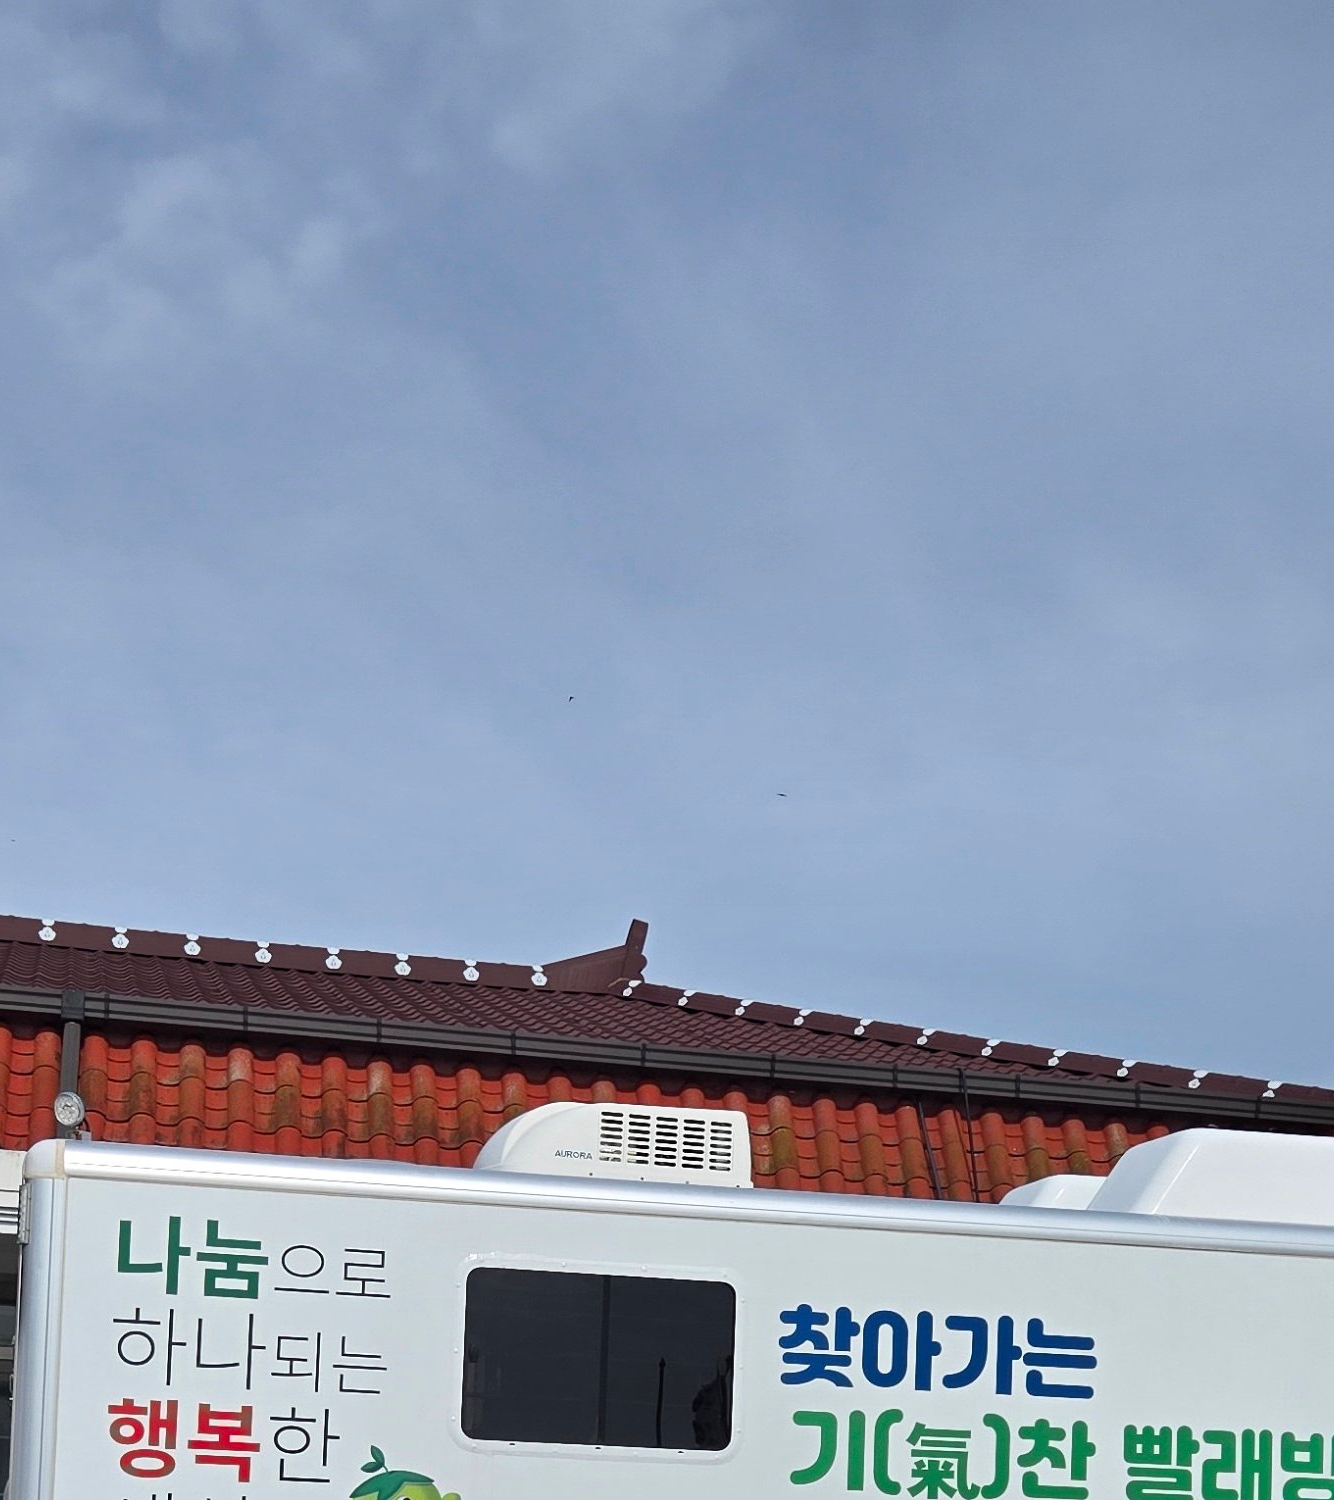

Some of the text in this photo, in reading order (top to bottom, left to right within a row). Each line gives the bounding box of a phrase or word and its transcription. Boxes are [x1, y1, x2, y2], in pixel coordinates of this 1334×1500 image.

[555, 1150, 593, 1160] AURORA
[117, 1215, 391, 1300] 나눔으로
[112, 1307, 388, 1395] 하나되는
[778, 1303, 1098, 1400] 찾아가는
[107, 1397, 341, 1483] 행복한
[789, 1407, 1096, 1500] 기(氣)찬
